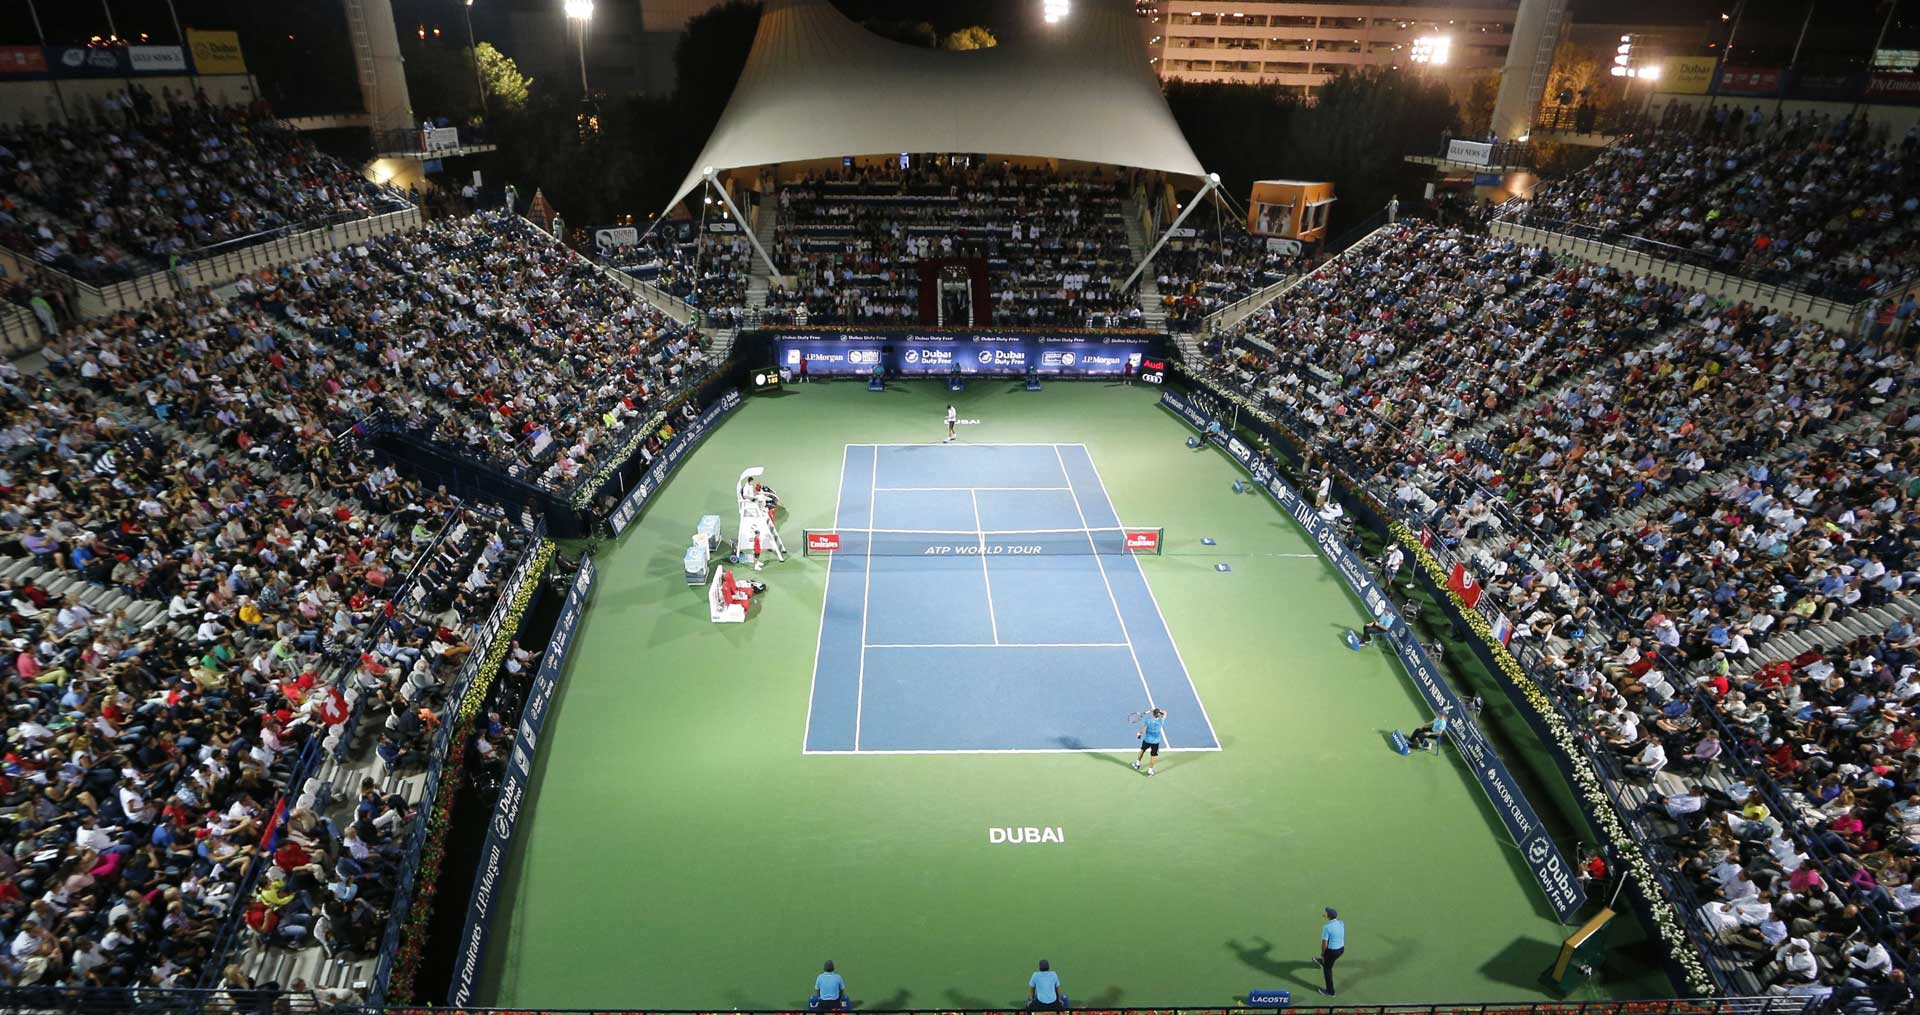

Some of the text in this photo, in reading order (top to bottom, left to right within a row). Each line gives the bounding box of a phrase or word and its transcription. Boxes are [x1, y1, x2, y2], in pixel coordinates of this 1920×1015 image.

[1465, 148, 1481, 157] NEWS
[922, 350, 952, 358] Dubai
[995, 350, 1025, 359] Dubai
[995, 358, 1009, 366] Duty
[1143, 360, 1164, 370] Audi
[1258, 462, 1272, 480] Dubai
[1294, 500, 1320, 534] TIME
[924, 546, 1042, 554] ATP WORLD TOUR
[1327, 533, 1343, 557] Dubai
[1418, 668, 1446, 707] GULF NEWS
[499, 776, 517, 814] Dubai
[1511, 804, 1531, 835] CREEK
[989, 827, 1065, 843] DUBAI
[475, 845, 501, 919] J.P.Morgan
[1546, 855, 1577, 905] Dubai
[1538, 868, 1566, 914] Duty Free
[461, 923, 482, 985] Emirates
[1252, 996, 1289, 1004] LACOSTE
